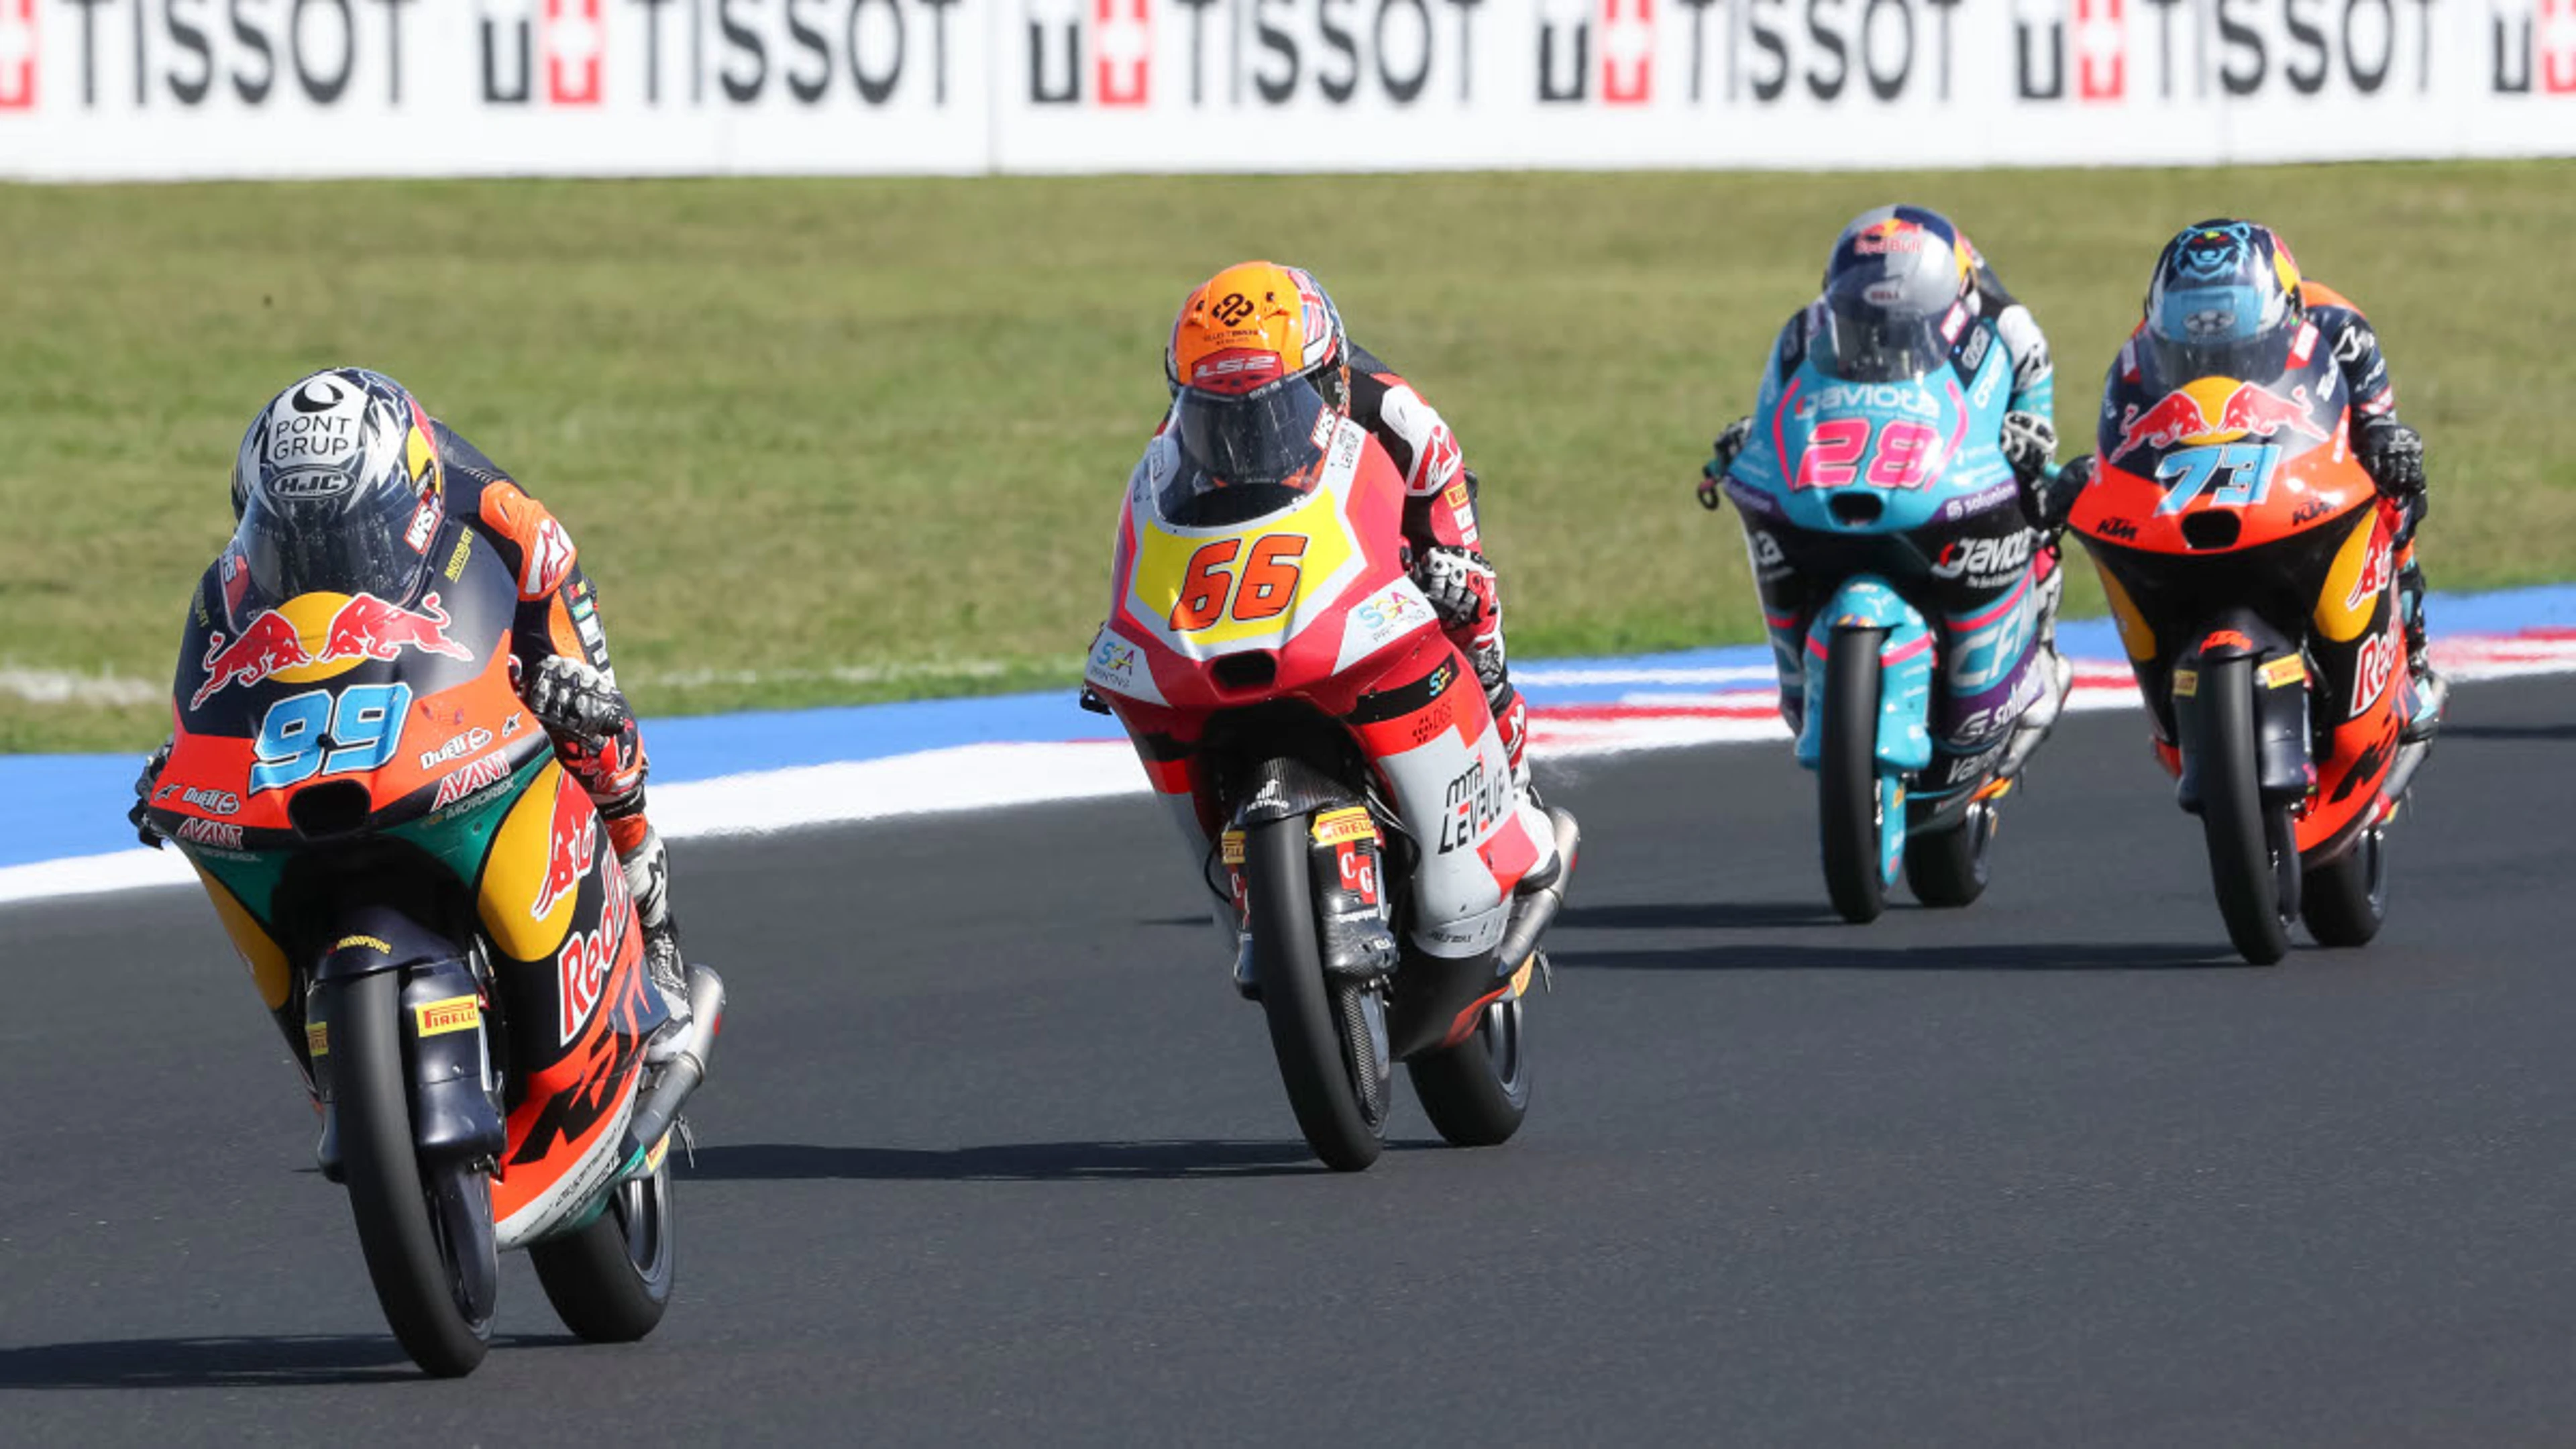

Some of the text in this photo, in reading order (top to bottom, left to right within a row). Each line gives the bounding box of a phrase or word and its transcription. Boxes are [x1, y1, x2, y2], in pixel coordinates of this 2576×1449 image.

[62, 0, 415, 107] TISSOT
[631, 0, 963, 106] TISSOT
[1173, 0, 1481, 106] TISSOT
[1676, 0, 1966, 103] TISSOT
[2144, 0, 2439, 97] TISSOT
[1195, 356, 1277, 378] LS2
[273, 436, 350, 460] GRUP
[275, 415, 353, 440] PONT
[1794, 417, 1943, 492] 28
[278, 475, 345, 493] HJC
[2153, 443, 2282, 519] 73
[1168, 533, 1309, 631] 66
[248, 681, 413, 796] 99
[429, 747, 512, 814] AVANT
[176, 816, 244, 851] AVANT
[423, 1002, 477, 1029] PIRELLI
